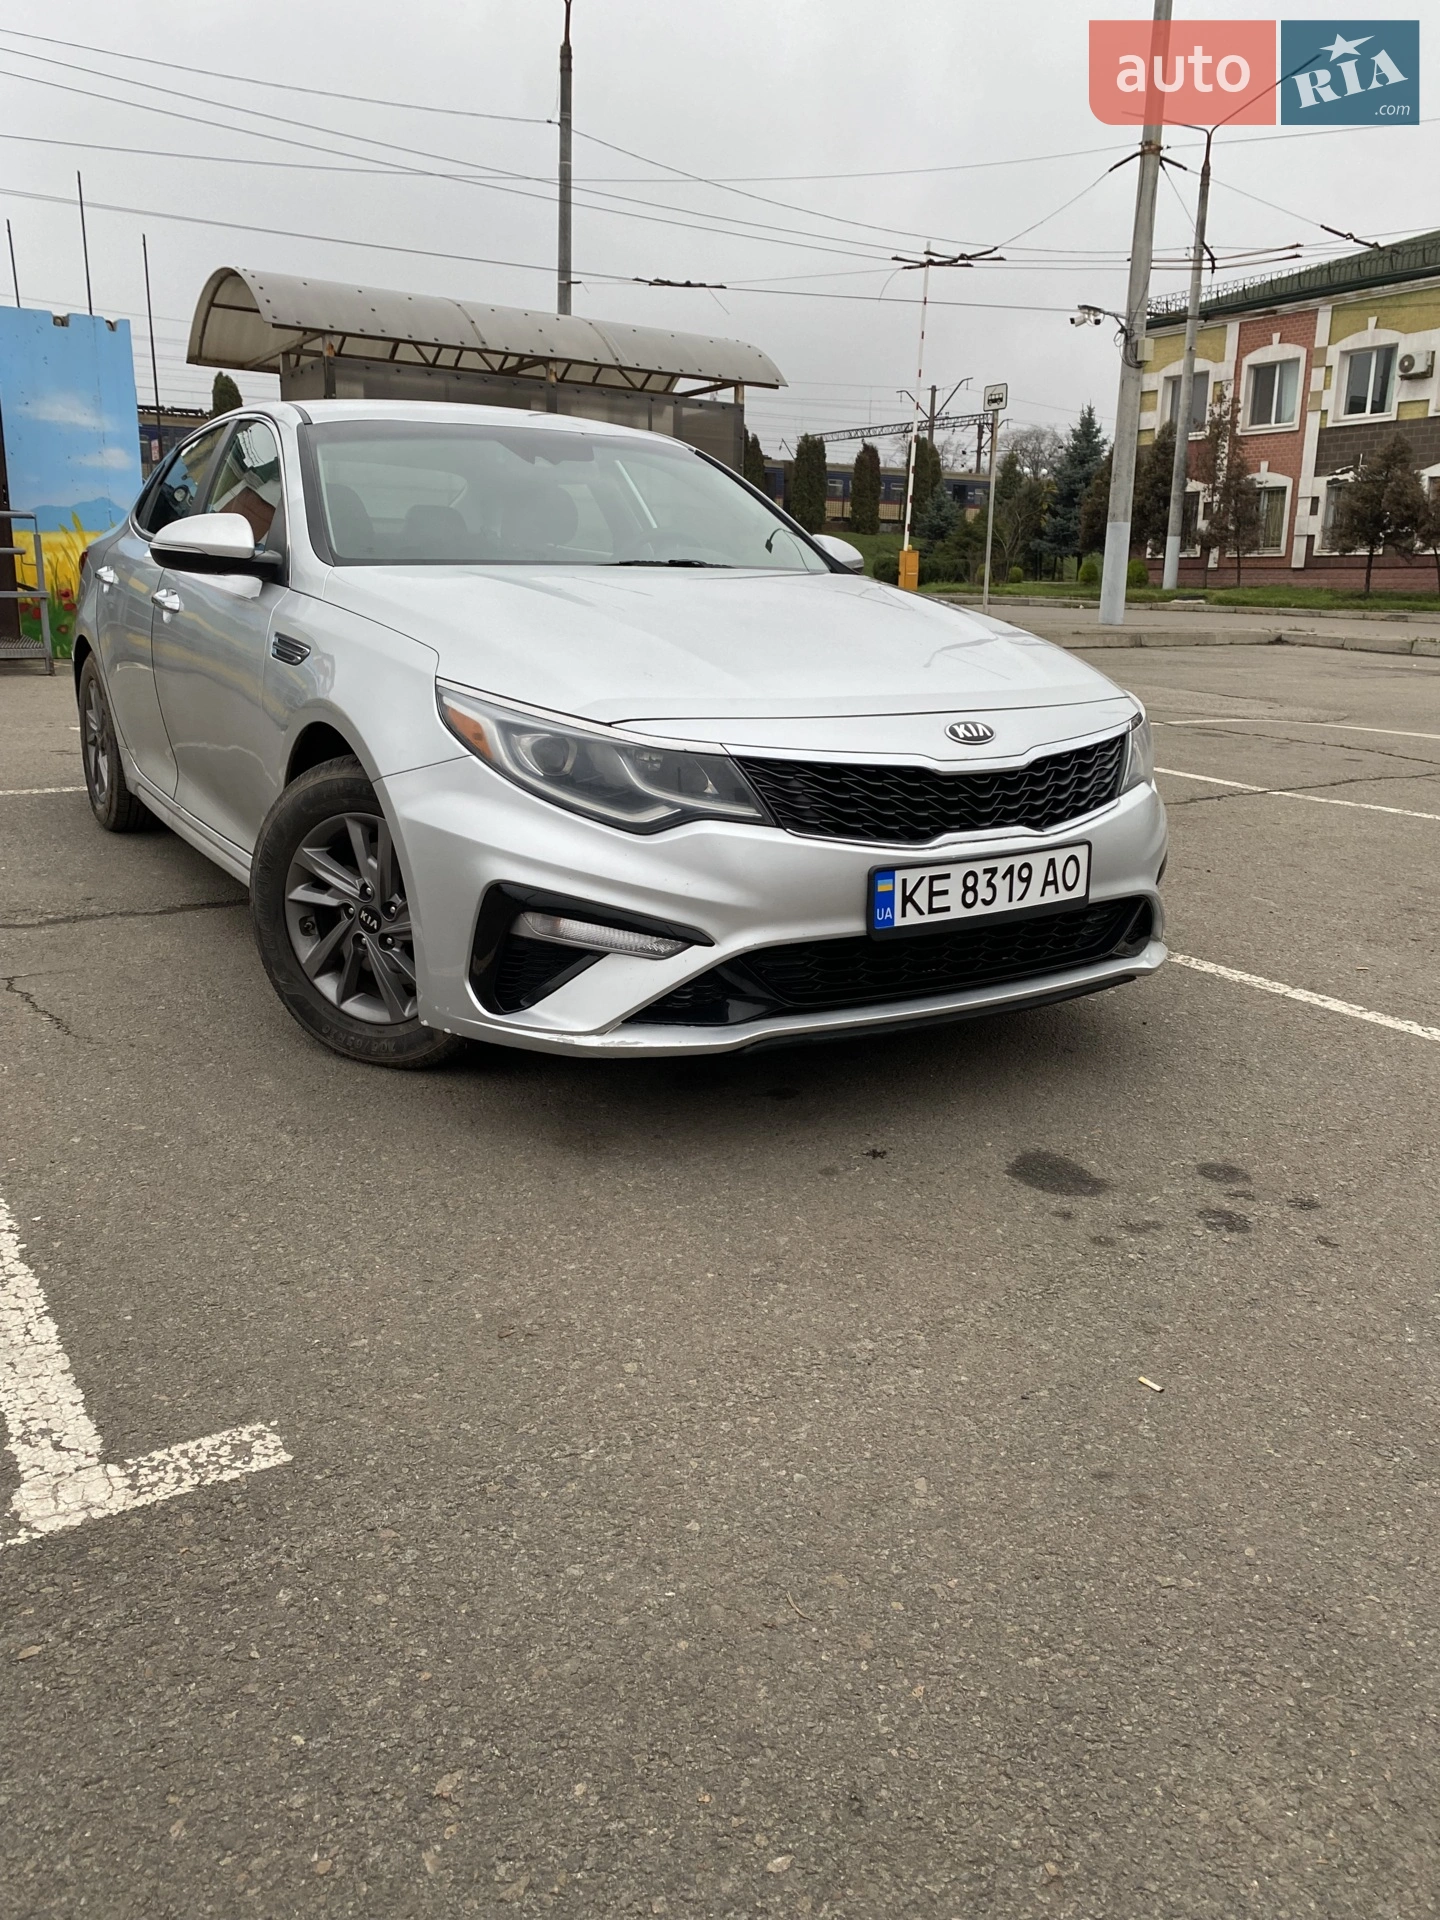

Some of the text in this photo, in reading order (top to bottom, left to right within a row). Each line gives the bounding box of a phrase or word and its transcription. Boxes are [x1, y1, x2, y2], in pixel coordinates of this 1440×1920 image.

[952, 722, 992, 739] KIA
[901, 854, 1081, 918] KE 8319 AO
[360, 910, 378, 930] KIA
[876, 906, 893, 921] UA
